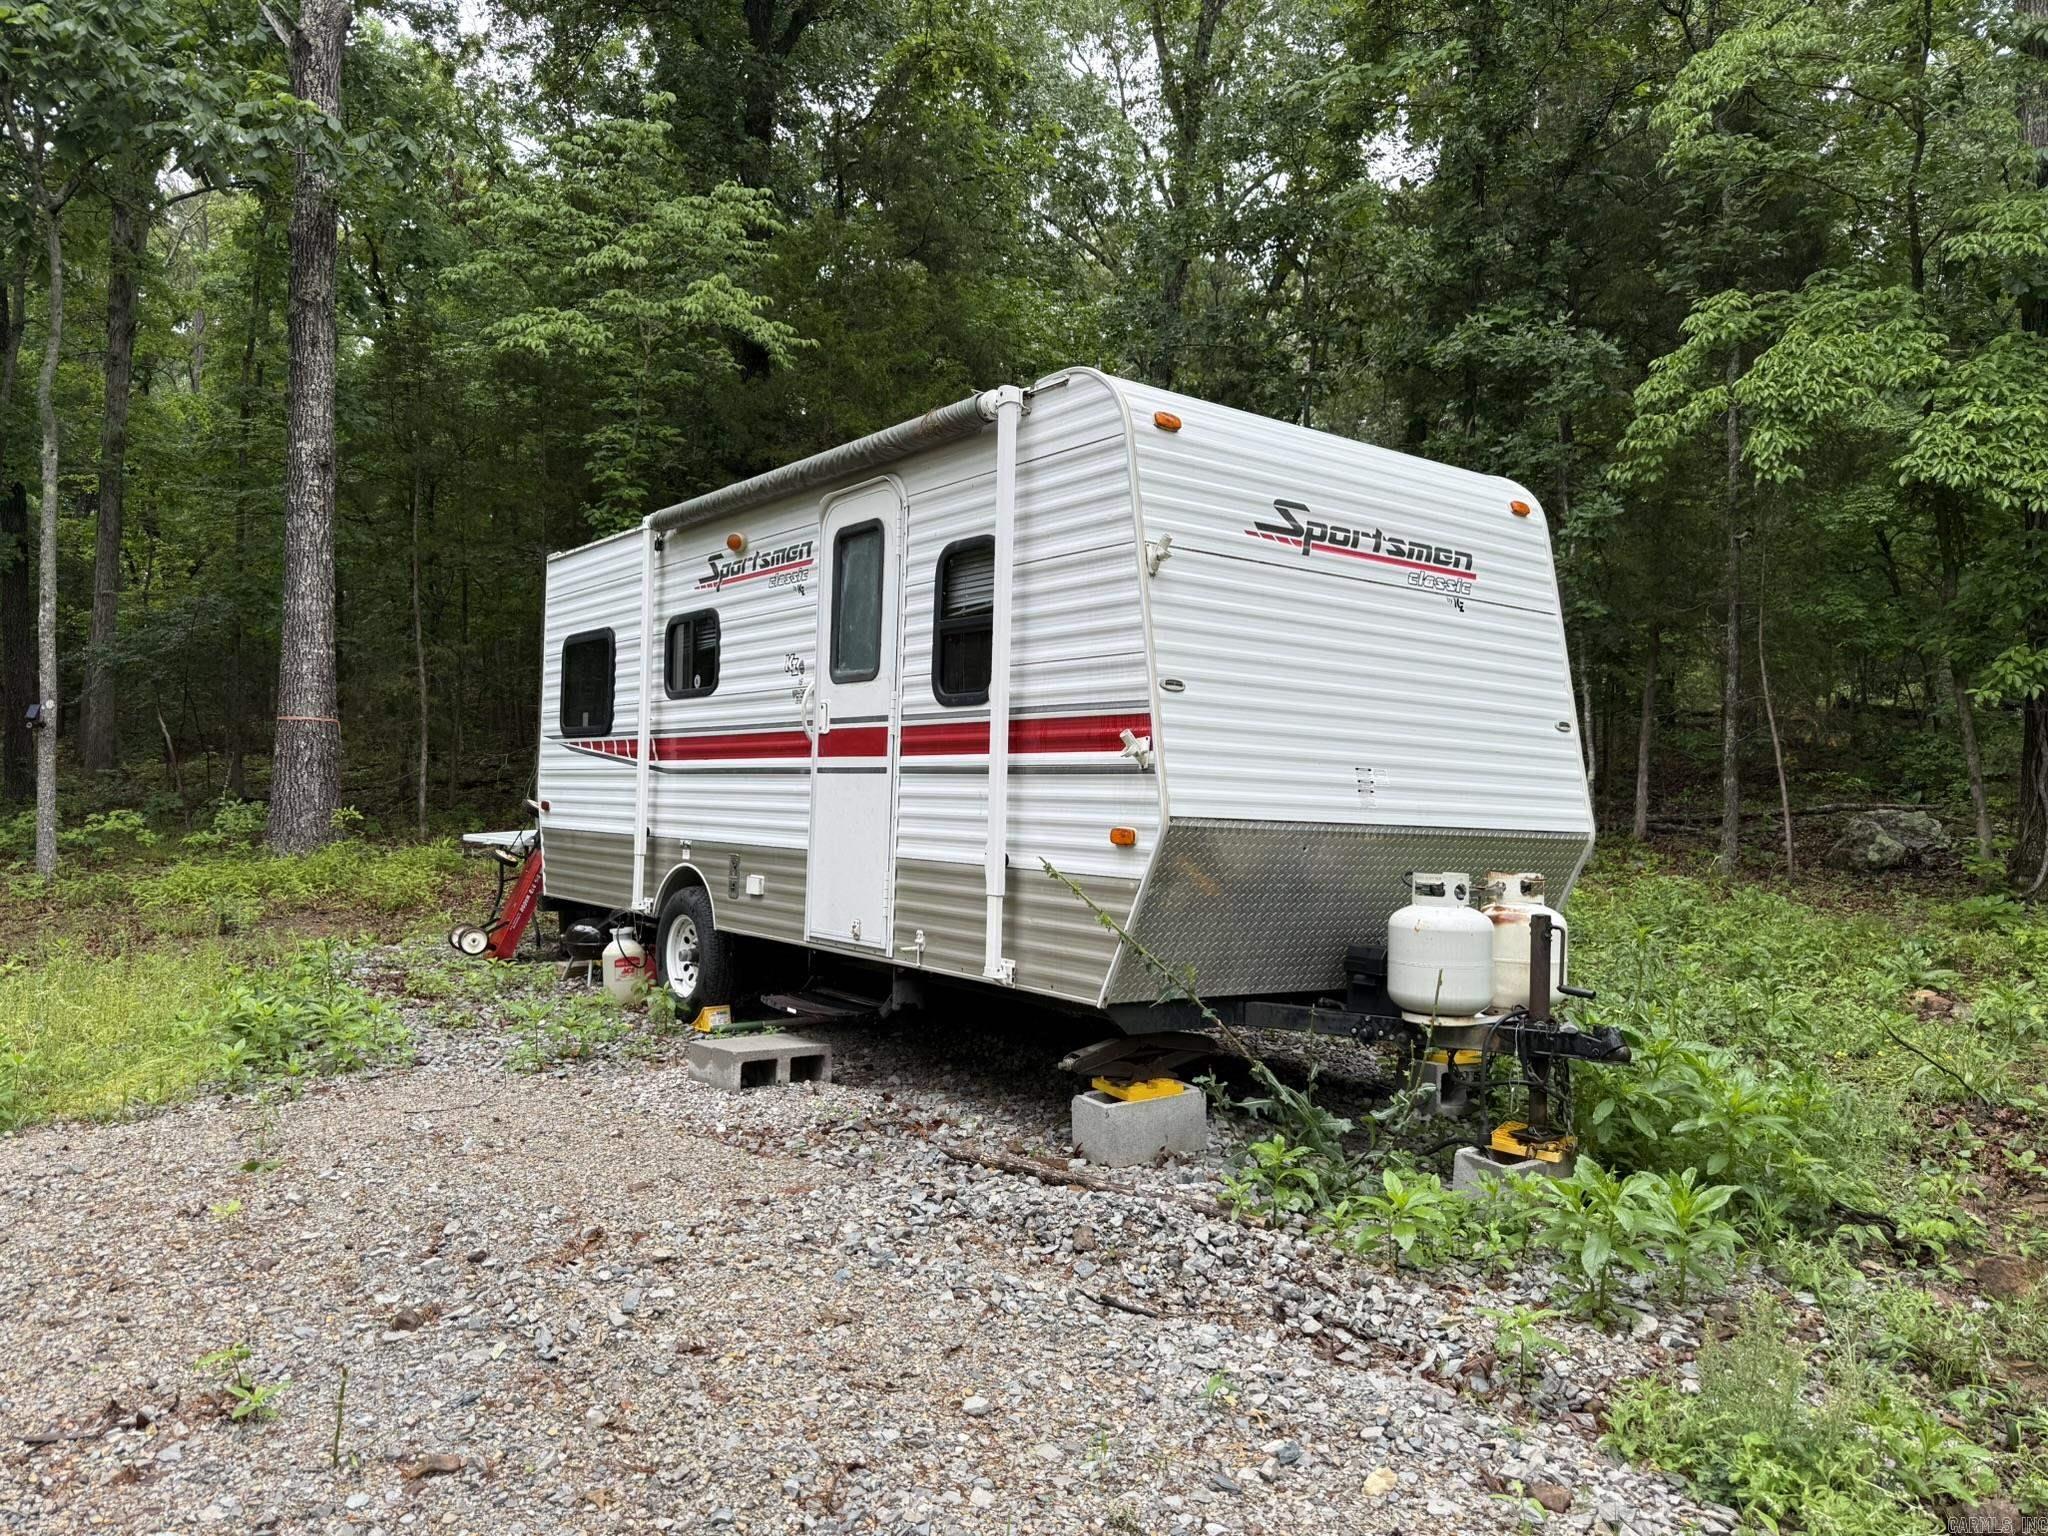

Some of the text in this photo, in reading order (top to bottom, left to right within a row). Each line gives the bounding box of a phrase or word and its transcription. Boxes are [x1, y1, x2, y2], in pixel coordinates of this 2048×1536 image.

[1254, 499, 1473, 571] Sportsmen
[699, 541, 813, 592] Sportsmen
[768, 567, 809, 589] classic
[1408, 571, 1472, 595] classic
